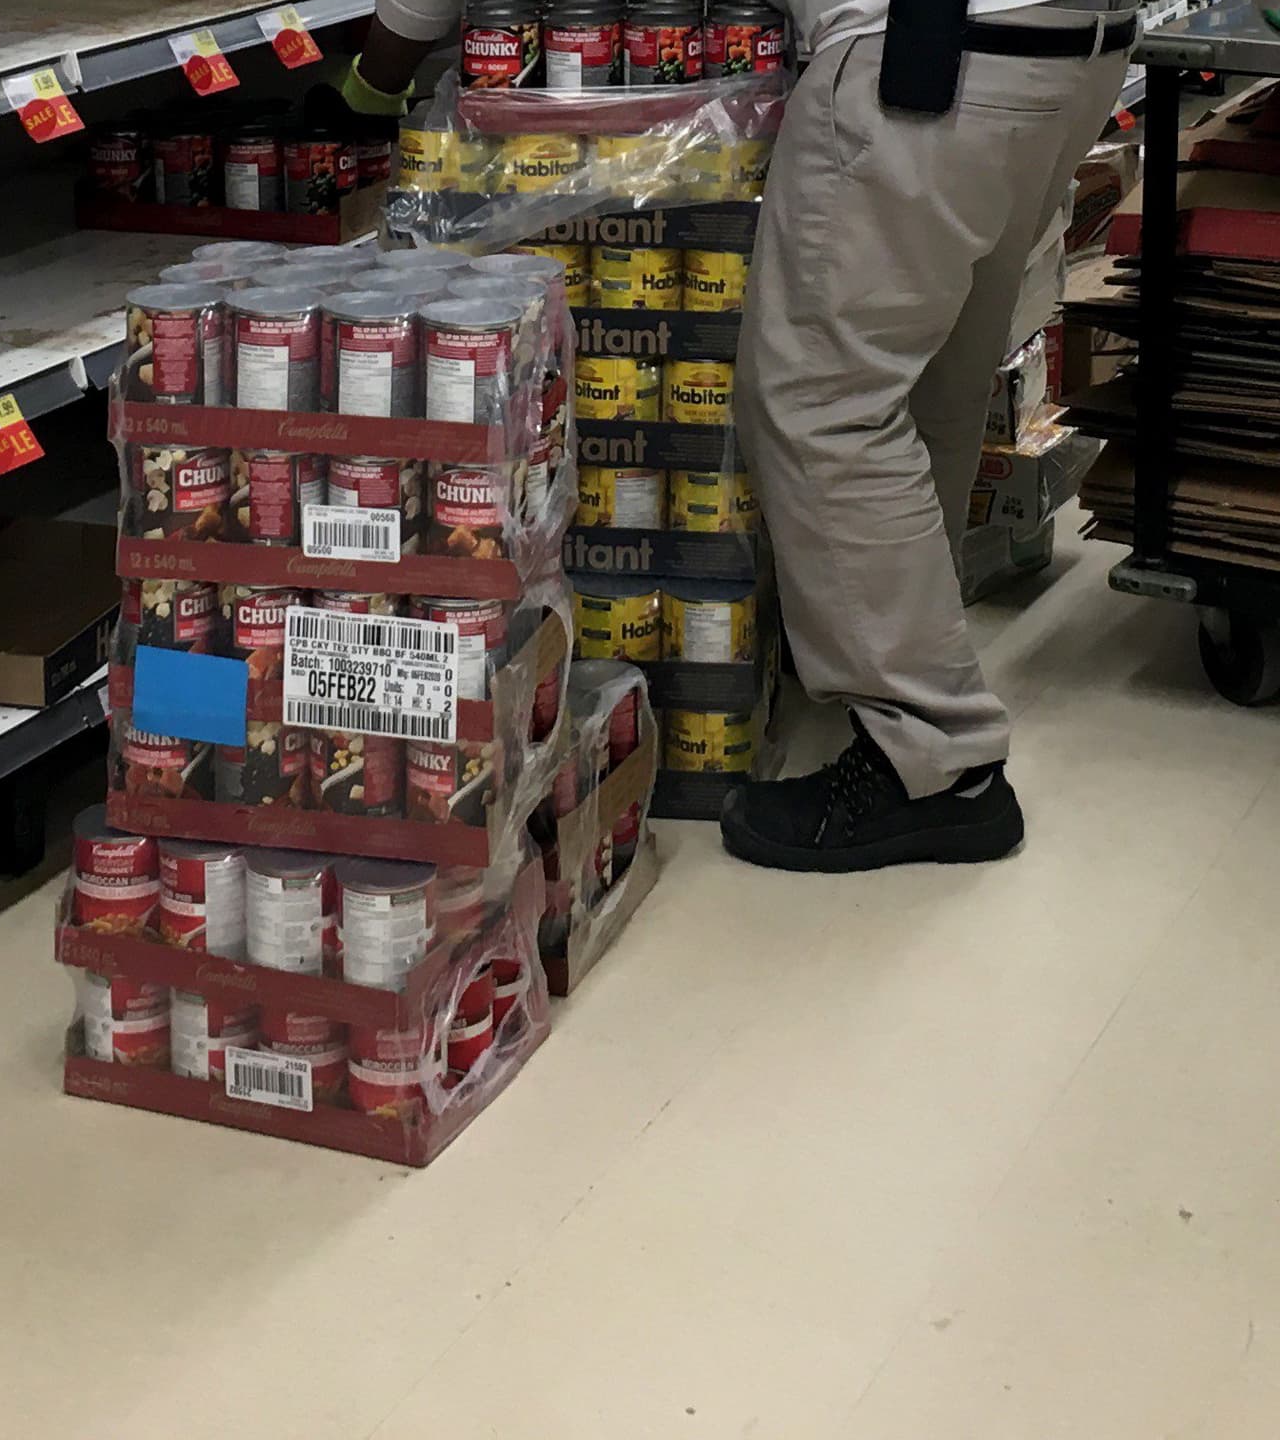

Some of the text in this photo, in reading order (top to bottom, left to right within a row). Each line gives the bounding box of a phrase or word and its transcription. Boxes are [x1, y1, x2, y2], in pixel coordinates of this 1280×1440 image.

[464, 40, 519, 58] CHUNKY
[189, 64, 211, 84] SALE
[25, 109, 54, 131] SALE
[669, 384, 730, 406] Habita
[436, 480, 500, 504] CHUNK
[130, 554, 143, 570] 12
[152, 554, 177, 571] 540
[289, 638, 440, 663] CPB CKY TEX STY BBQ BF 540ML
[291, 653, 324, 670] Batch:
[329, 657, 392, 678] 1003239710
[308, 670, 376, 703] 05FEB22
[384, 680, 405, 694] Units:
[394, 694, 402, 707] 14
[81, 873, 129, 887] MOROCCAN
